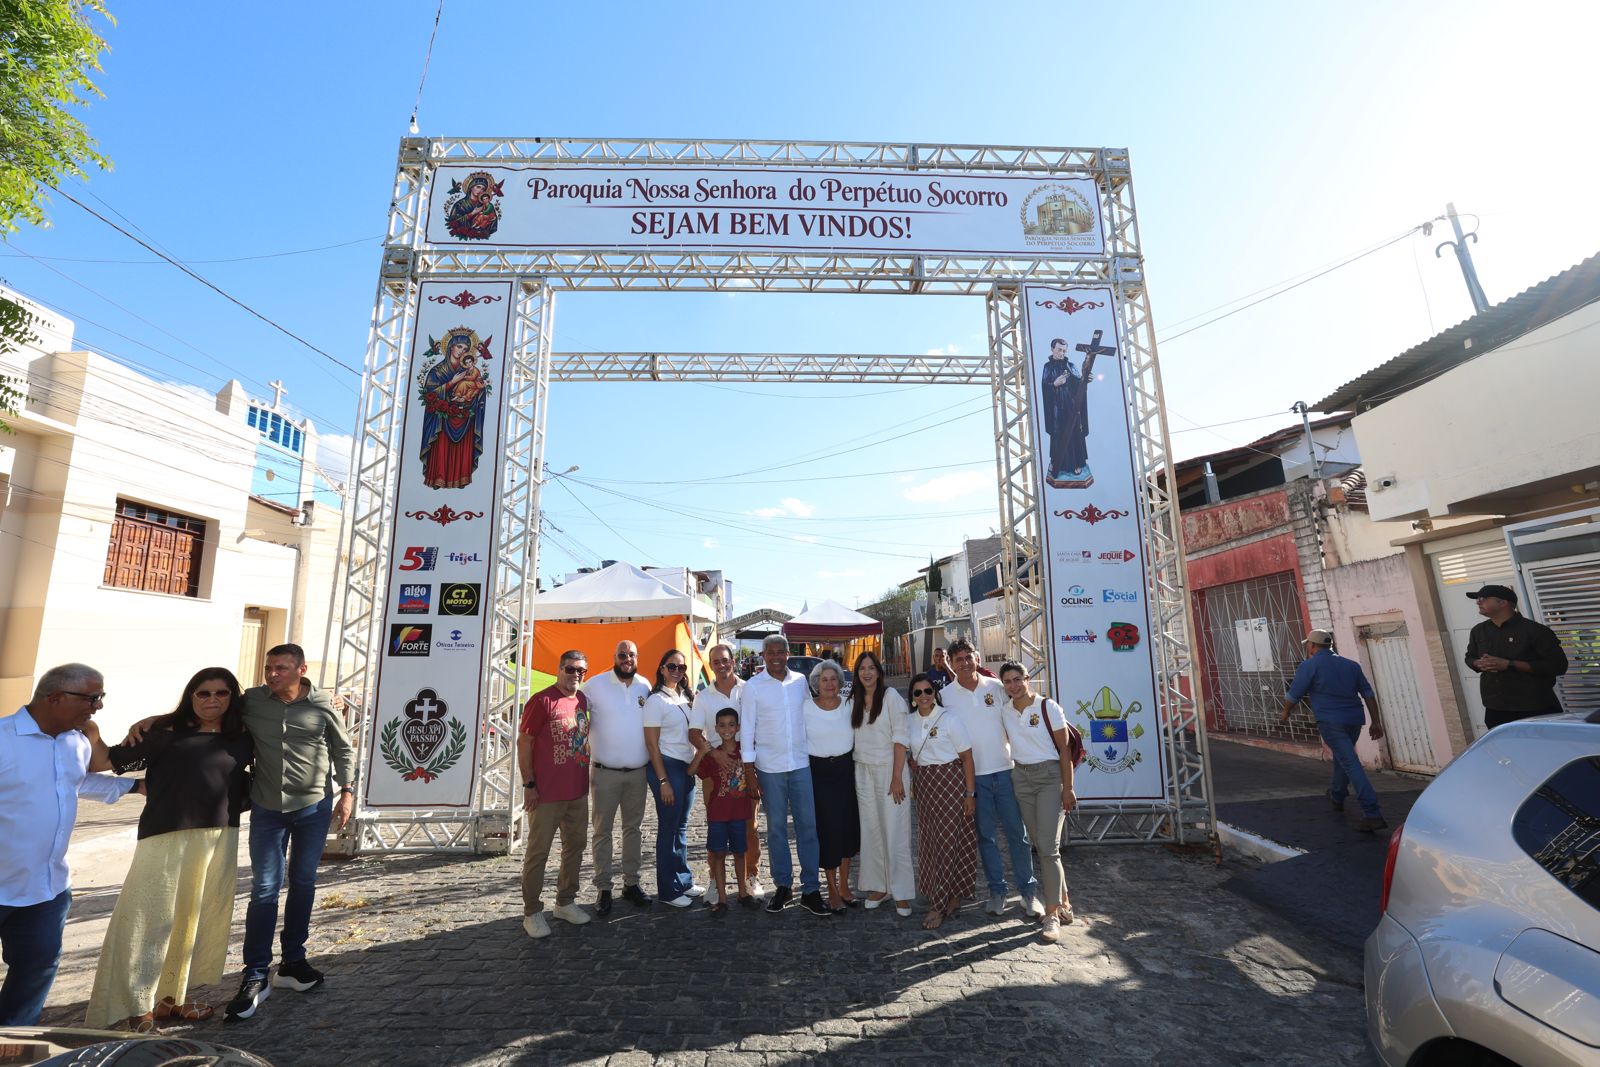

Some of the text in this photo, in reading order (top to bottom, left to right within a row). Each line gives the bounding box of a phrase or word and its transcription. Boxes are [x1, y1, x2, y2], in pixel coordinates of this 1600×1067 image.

[527, 177, 1008, 208] Paroquia Nossa Senhora do Perpétuo Socorro
[631, 212, 912, 240] SEJAM BEM VINDOS!
[1097, 550, 1123, 560] JEQUIÉ
[404, 585, 427, 598] algo
[451, 589, 468, 598] CT
[1061, 597, 1094, 605] OCLINIC
[401, 642, 429, 651] FORTE
[407, 725, 428, 734] JESU
[410, 734, 438, 742] PASSIO
